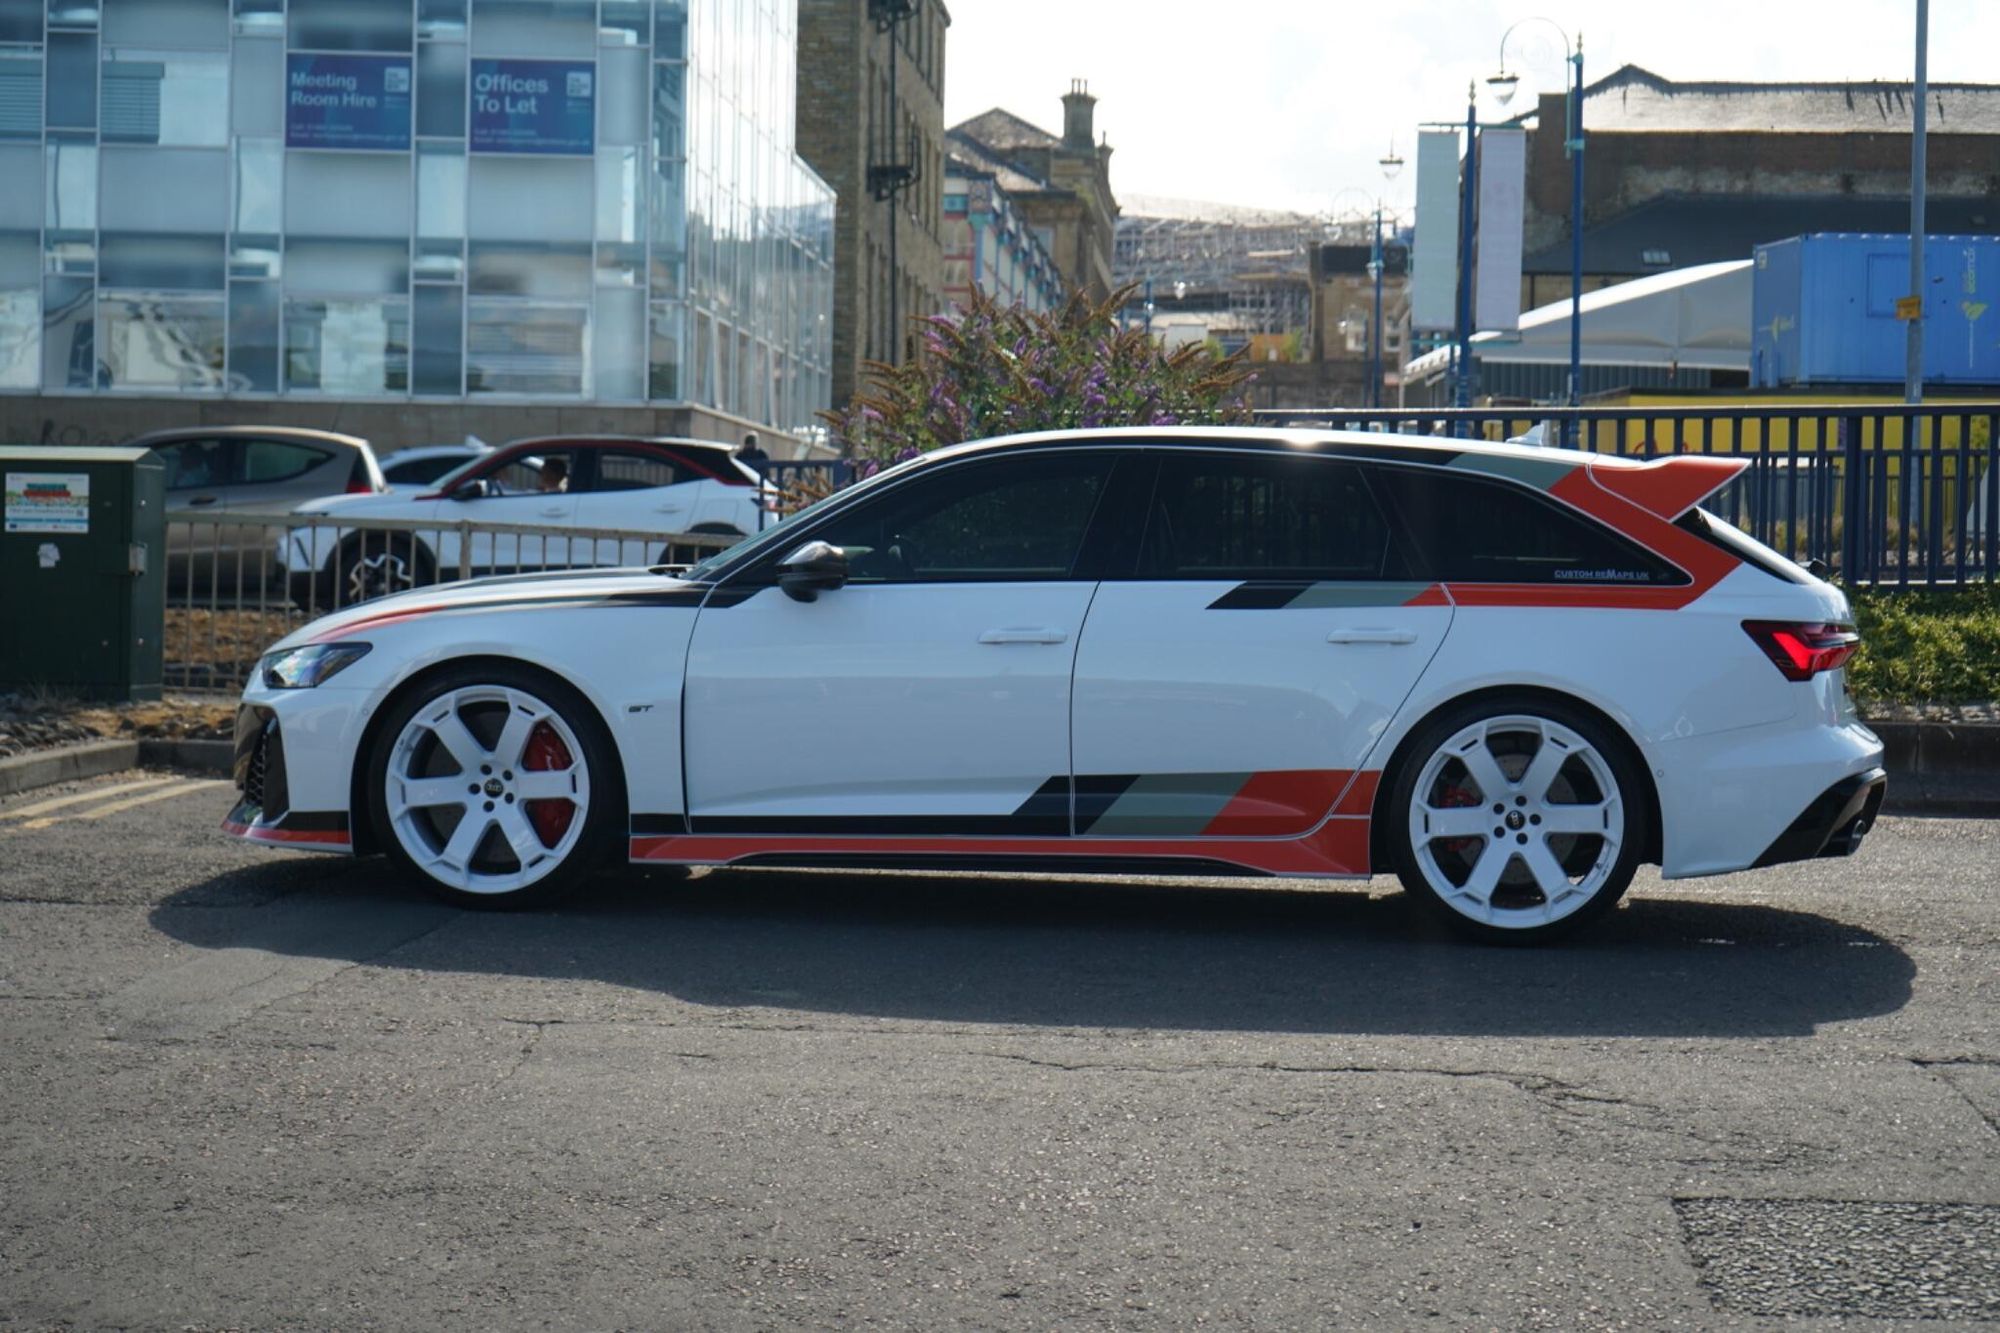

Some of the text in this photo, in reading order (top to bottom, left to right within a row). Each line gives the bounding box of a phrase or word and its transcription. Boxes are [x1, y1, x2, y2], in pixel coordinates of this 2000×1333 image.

[291, 72, 357, 91] Meeting
[475, 73, 549, 93] Offices
[291, 90, 339, 107] Room
[342, 92, 377, 108] Hire
[475, 94, 538, 114] To Let
[1554, 569, 1593, 579] CUSTOM
[1636, 571, 1649, 580] UK
